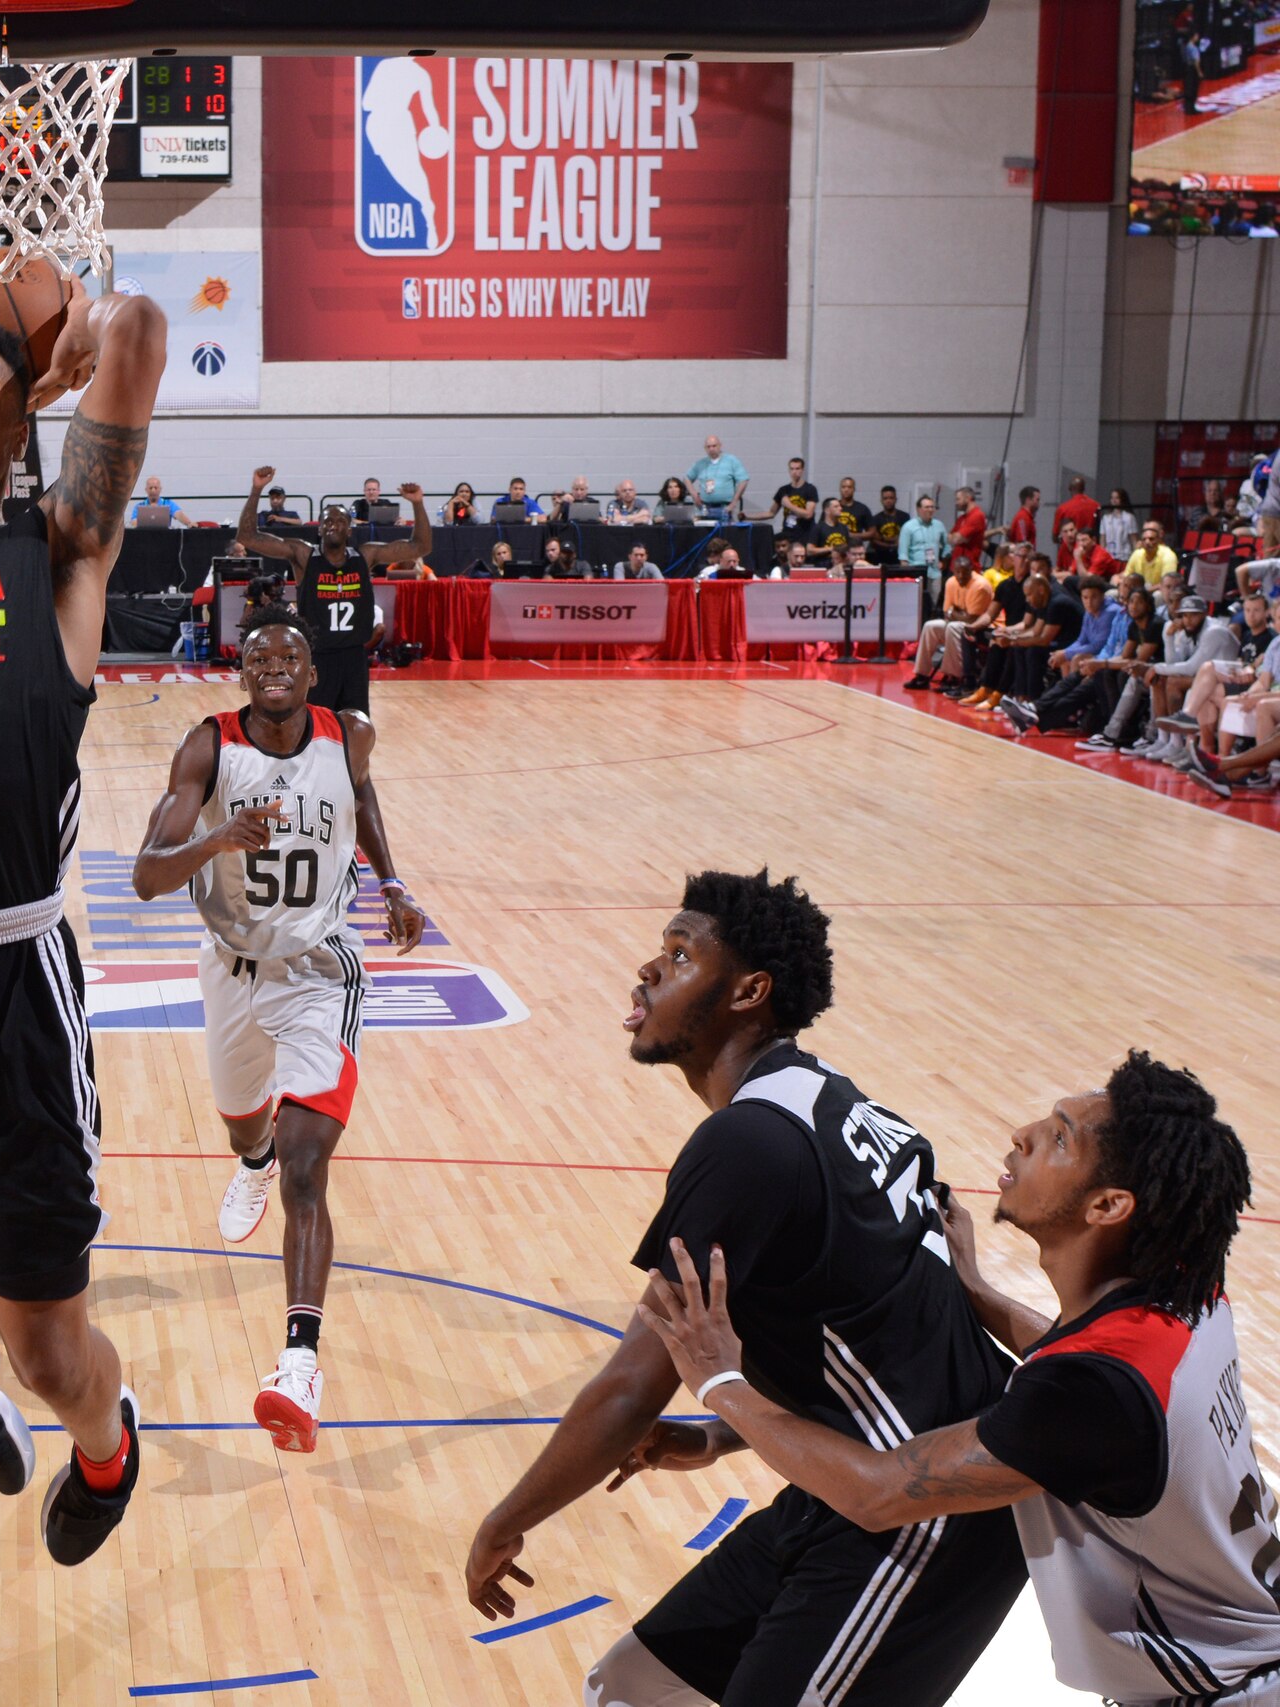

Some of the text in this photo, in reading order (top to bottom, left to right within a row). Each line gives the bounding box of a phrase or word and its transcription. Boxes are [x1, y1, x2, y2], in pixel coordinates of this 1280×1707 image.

[144, 65, 171, 85] 28
[185, 65, 192, 83] 1
[213, 64, 226, 85] 3
[146, 94, 171, 114] 33
[185, 94, 192, 113] 1
[206, 94, 226, 114] 10
[472, 58, 700, 151] SUMMER
[160, 154, 209, 164] 739-FANS
[1216, 175, 1254, 190] ATL
[475, 155, 663, 251] LEAGUE
[369, 203, 416, 239] NBA
[424, 277, 650, 318] THIS IS WHY WE PLAY
[317, 572, 361, 583] ATLANTA
[317, 590, 361, 599] BASKETBALL
[328, 601, 355, 632] 12
[557, 605, 637, 621] TISSOT
[787, 603, 866, 620] verizon
[245, 848, 319, 908] 50
